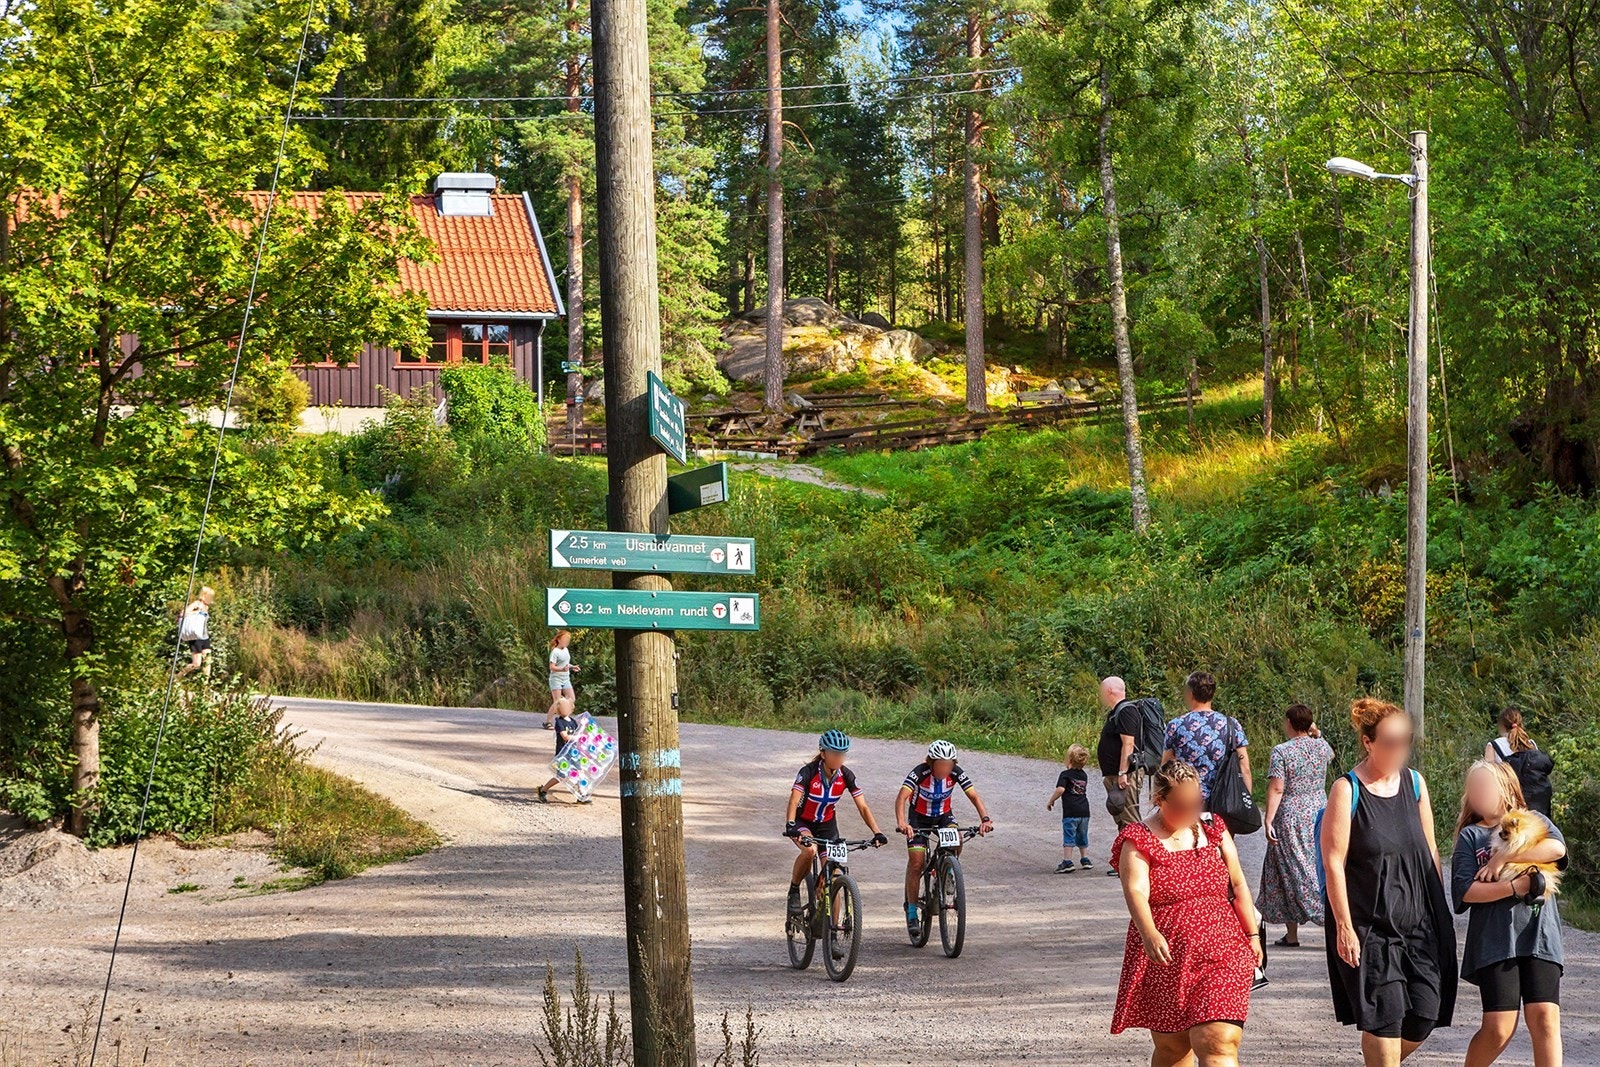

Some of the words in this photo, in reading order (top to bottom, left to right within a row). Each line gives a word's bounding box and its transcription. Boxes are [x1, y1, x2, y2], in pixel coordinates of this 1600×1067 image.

[569, 535, 588, 550] 2,5
[593, 541, 606, 550] km
[626, 539, 706, 553] Ulsrudvannet
[569, 556, 607, 566] (umerket
[611, 557, 626, 566] vei)
[575, 604, 592, 615] 8,2
[598, 606, 612, 615] km
[617, 604, 673, 616] Nøklevann
[680, 606, 708, 617] rundt
[940, 831, 958, 842] 7601
[827, 845, 846, 858] 7553
